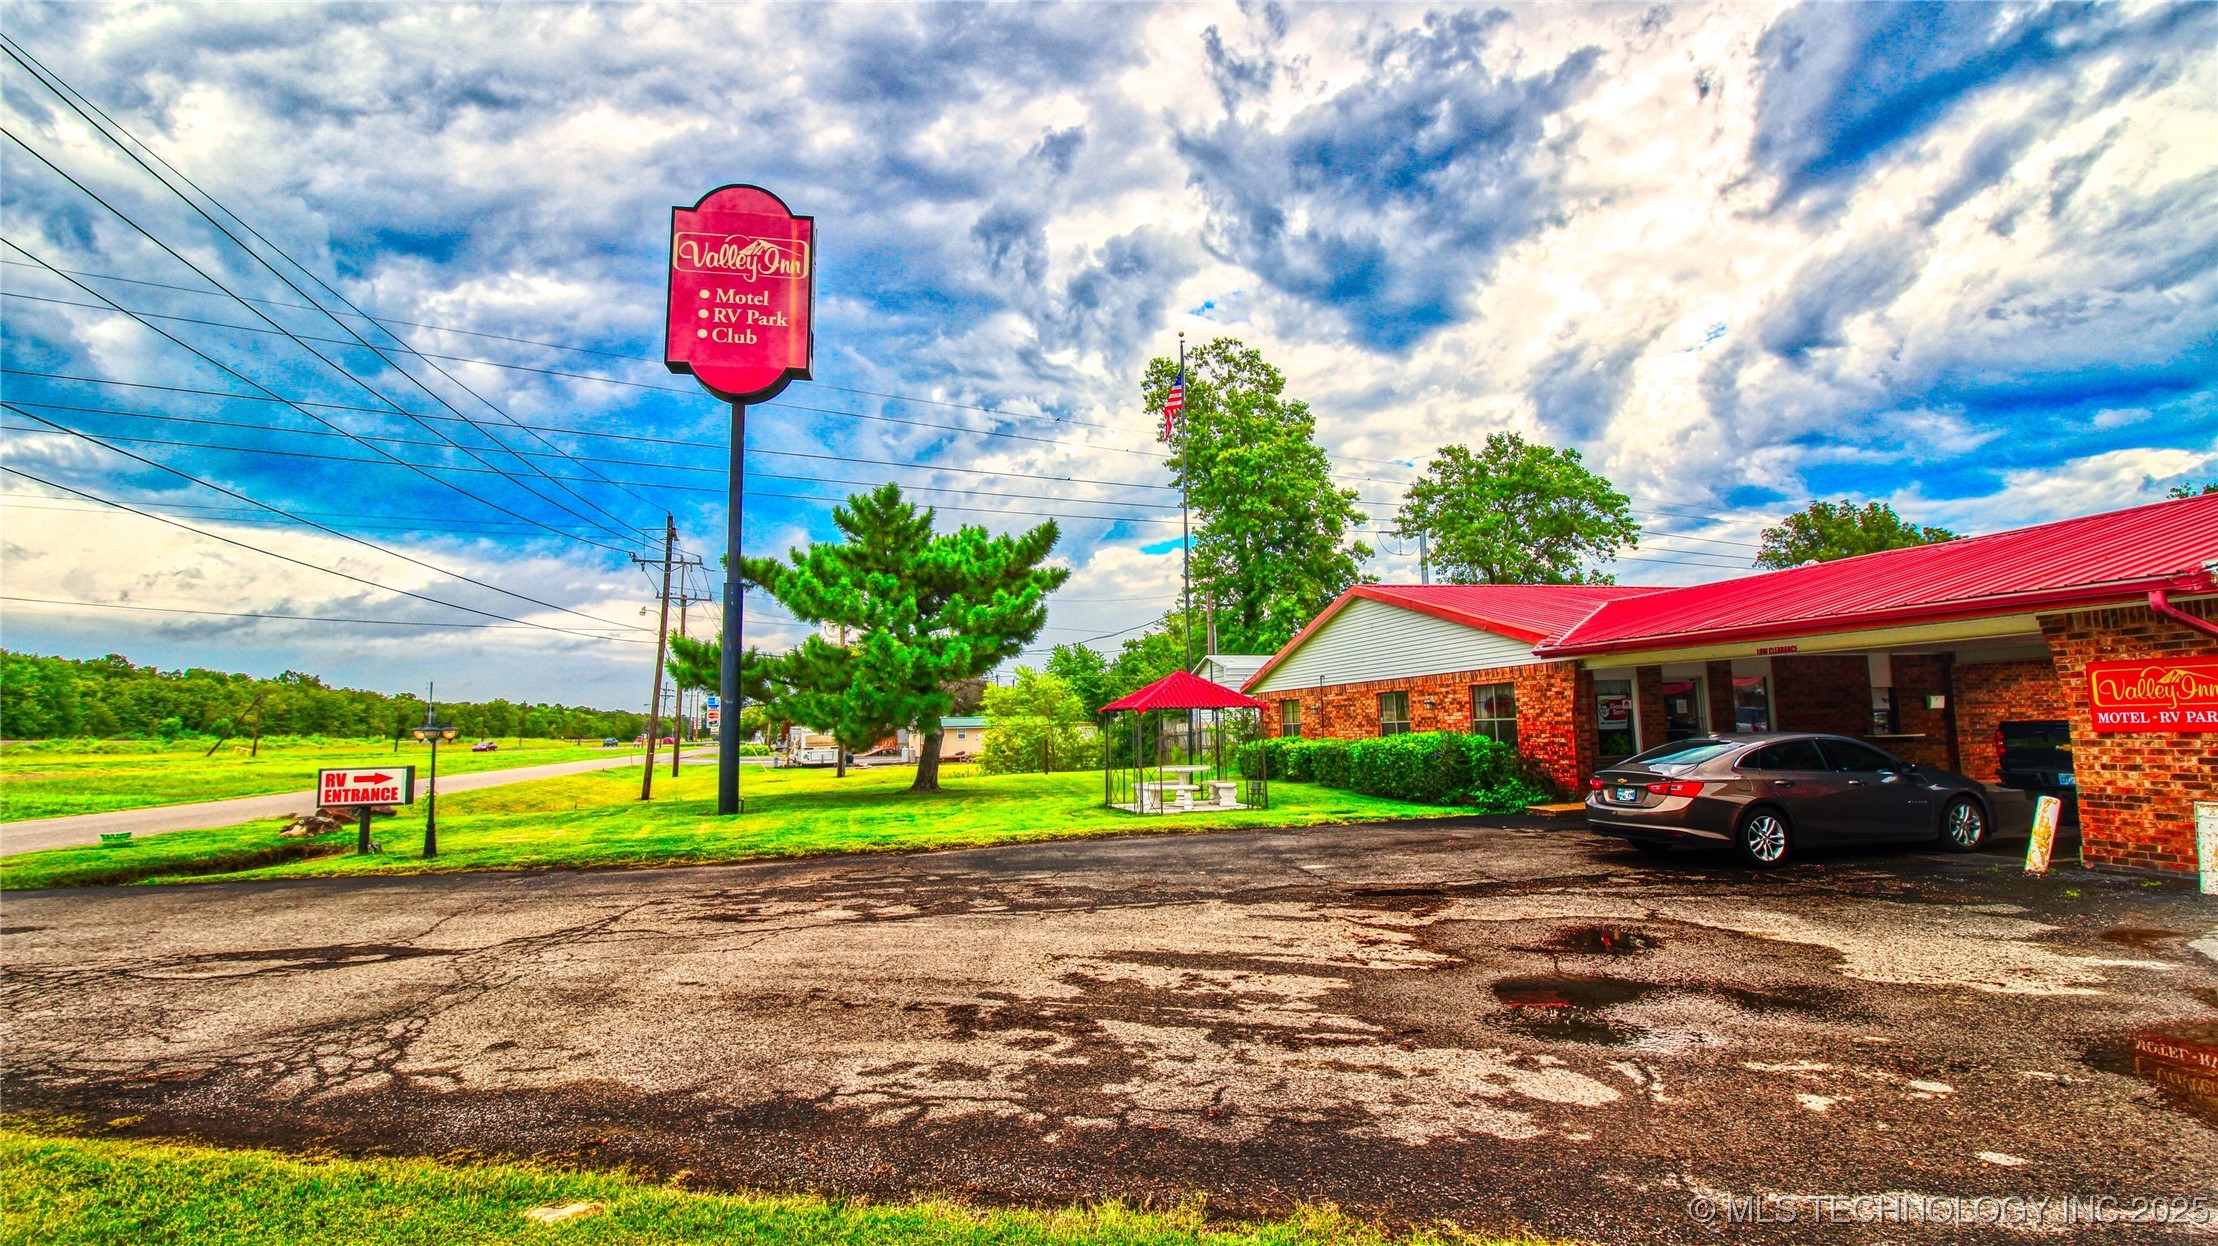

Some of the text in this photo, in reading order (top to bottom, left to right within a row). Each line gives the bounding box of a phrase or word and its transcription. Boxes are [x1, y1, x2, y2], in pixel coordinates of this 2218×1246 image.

[679, 241, 801, 282] Valley Inn
[715, 288, 769, 306] Motel
[712, 308, 788, 327] RV Park
[712, 327, 757, 345] Club
[2099, 675, 2218, 709] Valley Inn
[2097, 712, 2150, 723] MOTEL
[2159, 711, 2180, 723] RV
[325, 773, 347, 788] RV
[324, 787, 399, 803] ENTRANCE
